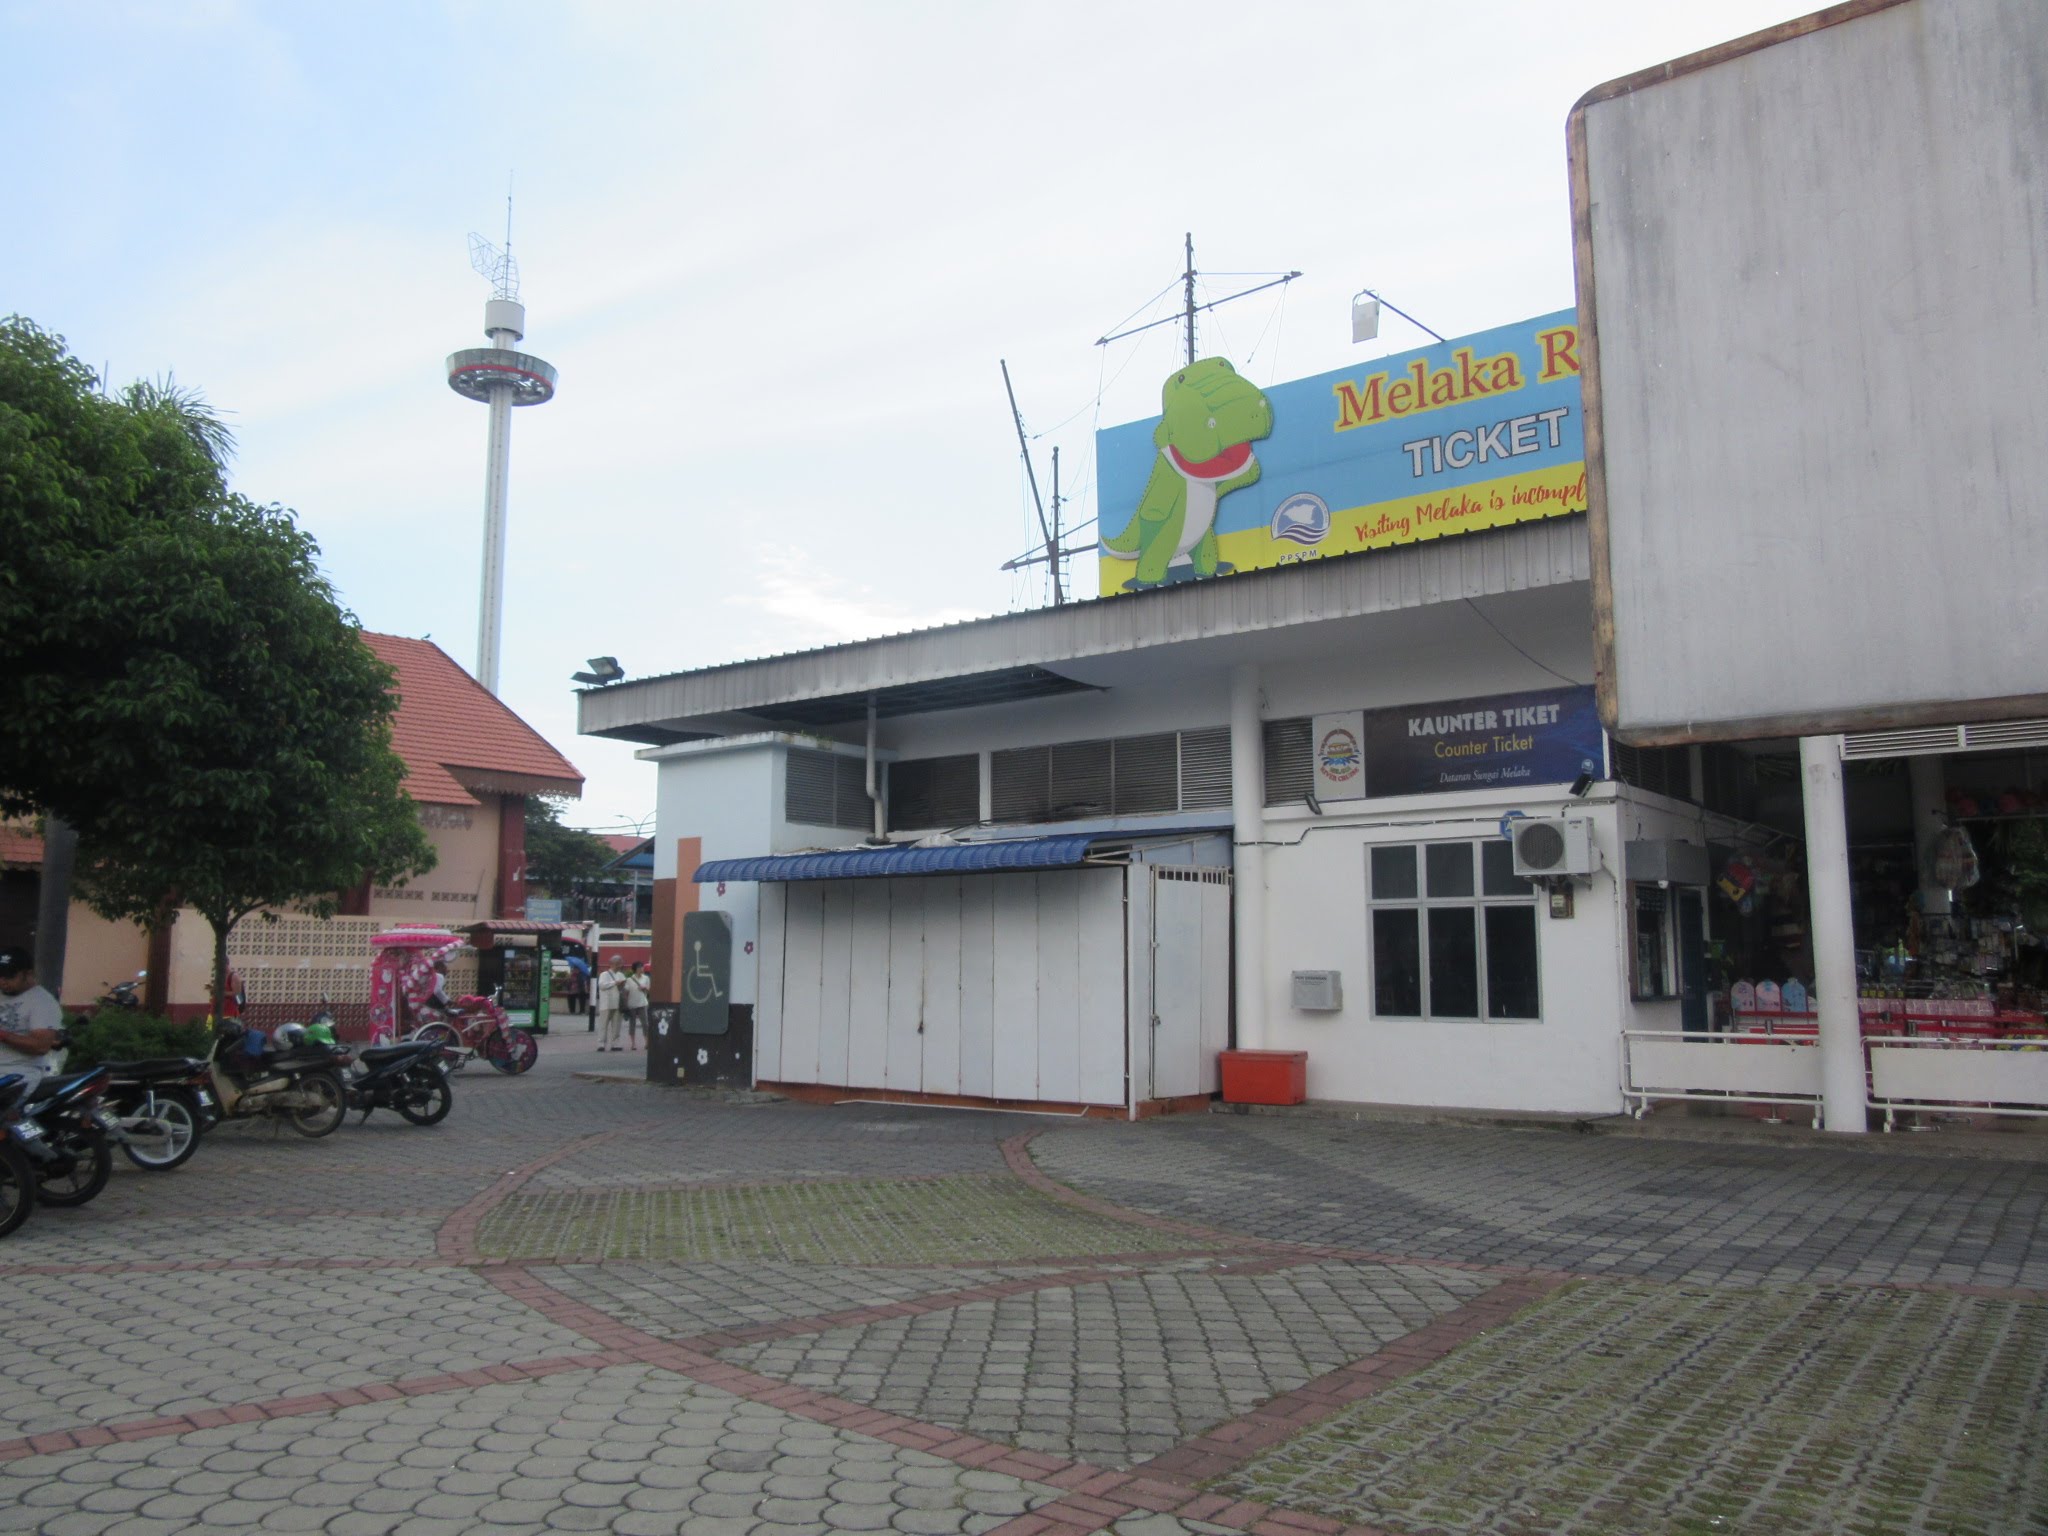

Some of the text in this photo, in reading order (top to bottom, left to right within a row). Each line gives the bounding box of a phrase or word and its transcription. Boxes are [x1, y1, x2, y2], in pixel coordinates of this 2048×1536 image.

[1336, 350, 1521, 429] Melaka
[1402, 406, 1569, 478] TICKET
[1354, 512, 1411, 543] Visiting
[1416, 493, 1483, 526] Melaka
[1489, 489, 1505, 511] is
[1280, 549, 1318, 563] PPSPM
[1408, 704, 1560, 737] KAUNTER TIKET
[1434, 732, 1534, 759] Counter Ticket
[1439, 765, 1532, 784] Dataran Sungai Melaka
